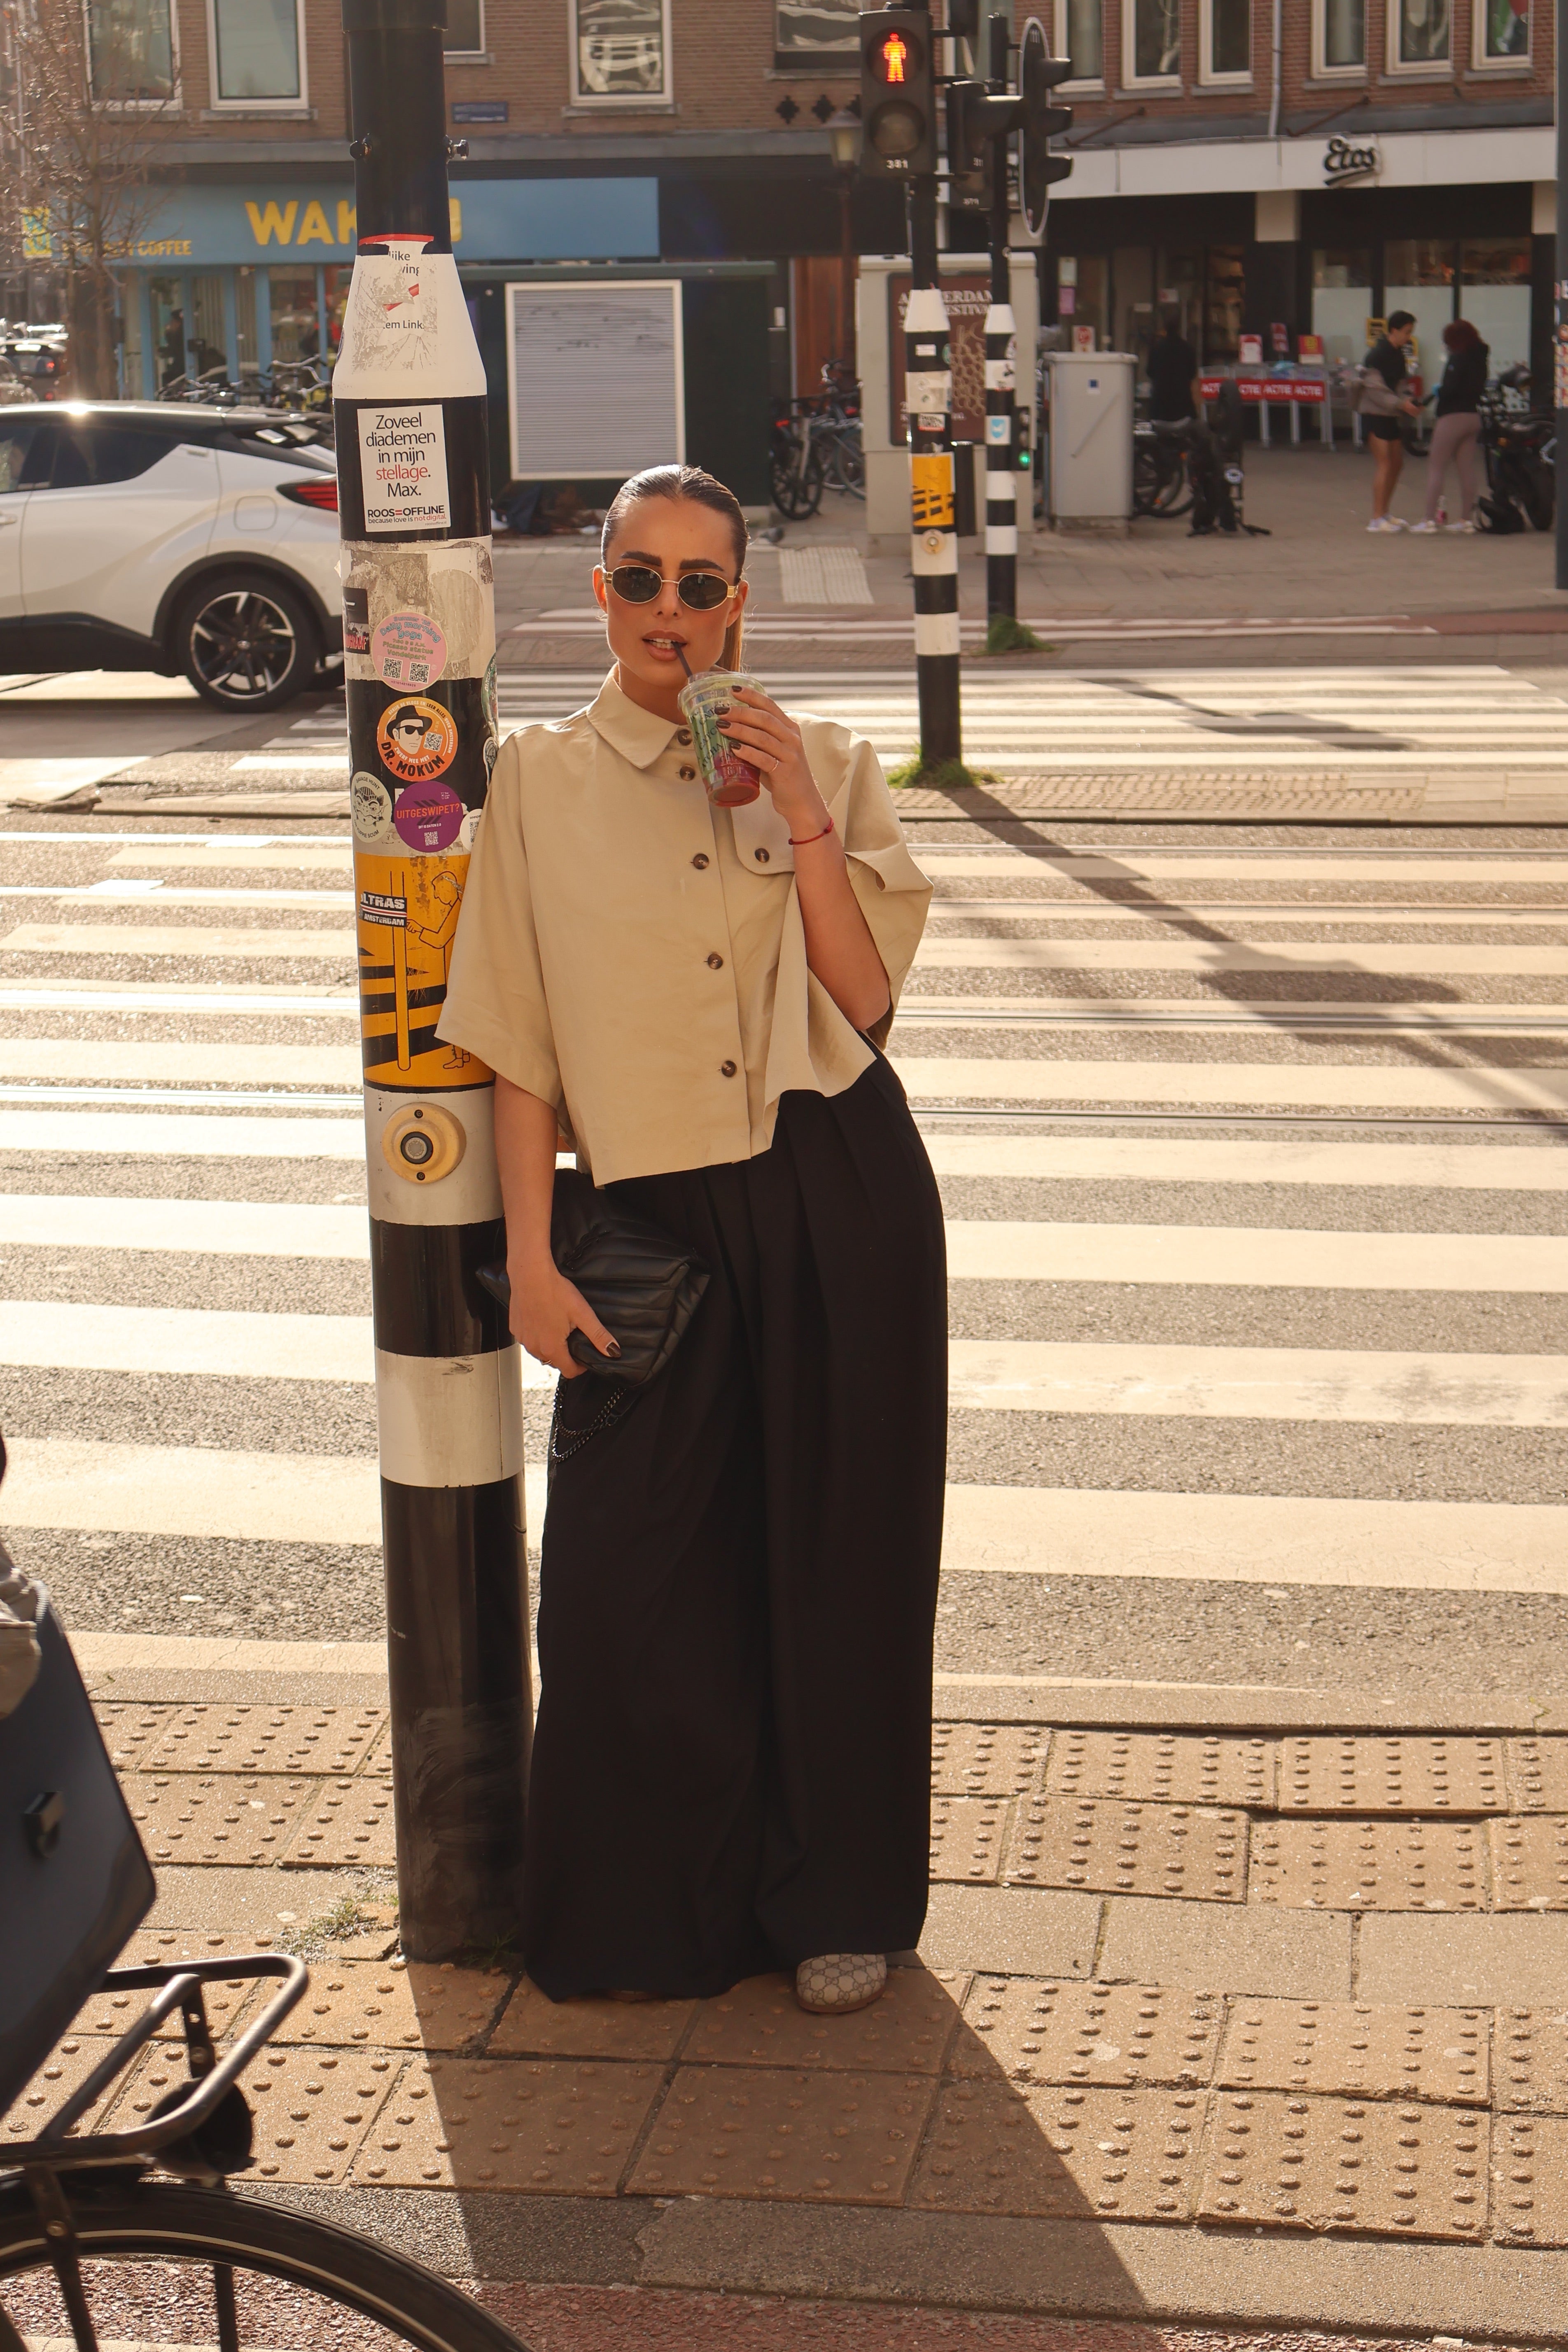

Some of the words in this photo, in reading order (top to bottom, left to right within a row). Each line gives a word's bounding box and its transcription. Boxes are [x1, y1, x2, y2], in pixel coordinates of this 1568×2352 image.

[138, 240, 192, 256] COFFEE
[376, 412, 422, 429] Zoveel
[366, 431, 436, 447] diademen
[378, 449, 390, 463] in
[394, 447, 425, 465] mijn
[376, 464, 431, 482] stellage.
[387, 483, 422, 497] Max.
[380, 622, 402, 636] Daily
[404, 622, 441, 643] morning
[398, 630, 422, 639] yoga
[383, 641, 408, 651] Picasso
[410, 646, 434, 654] statue
[387, 649, 427, 660] Vondelpark
[388, 705, 400, 715] BEKIJK
[436, 709, 446, 718] ALLES
[381, 742, 395, 765] DR.
[396, 755, 445, 777] MOKUM
[394, 747, 408, 761] ZWERF
[369, 779, 380, 790] HUNT
[397, 803, 460, 819] UITGESWIPET?
[368, 829, 379, 838] SCUM
[364, 913, 404, 926] AMSTERDAM
